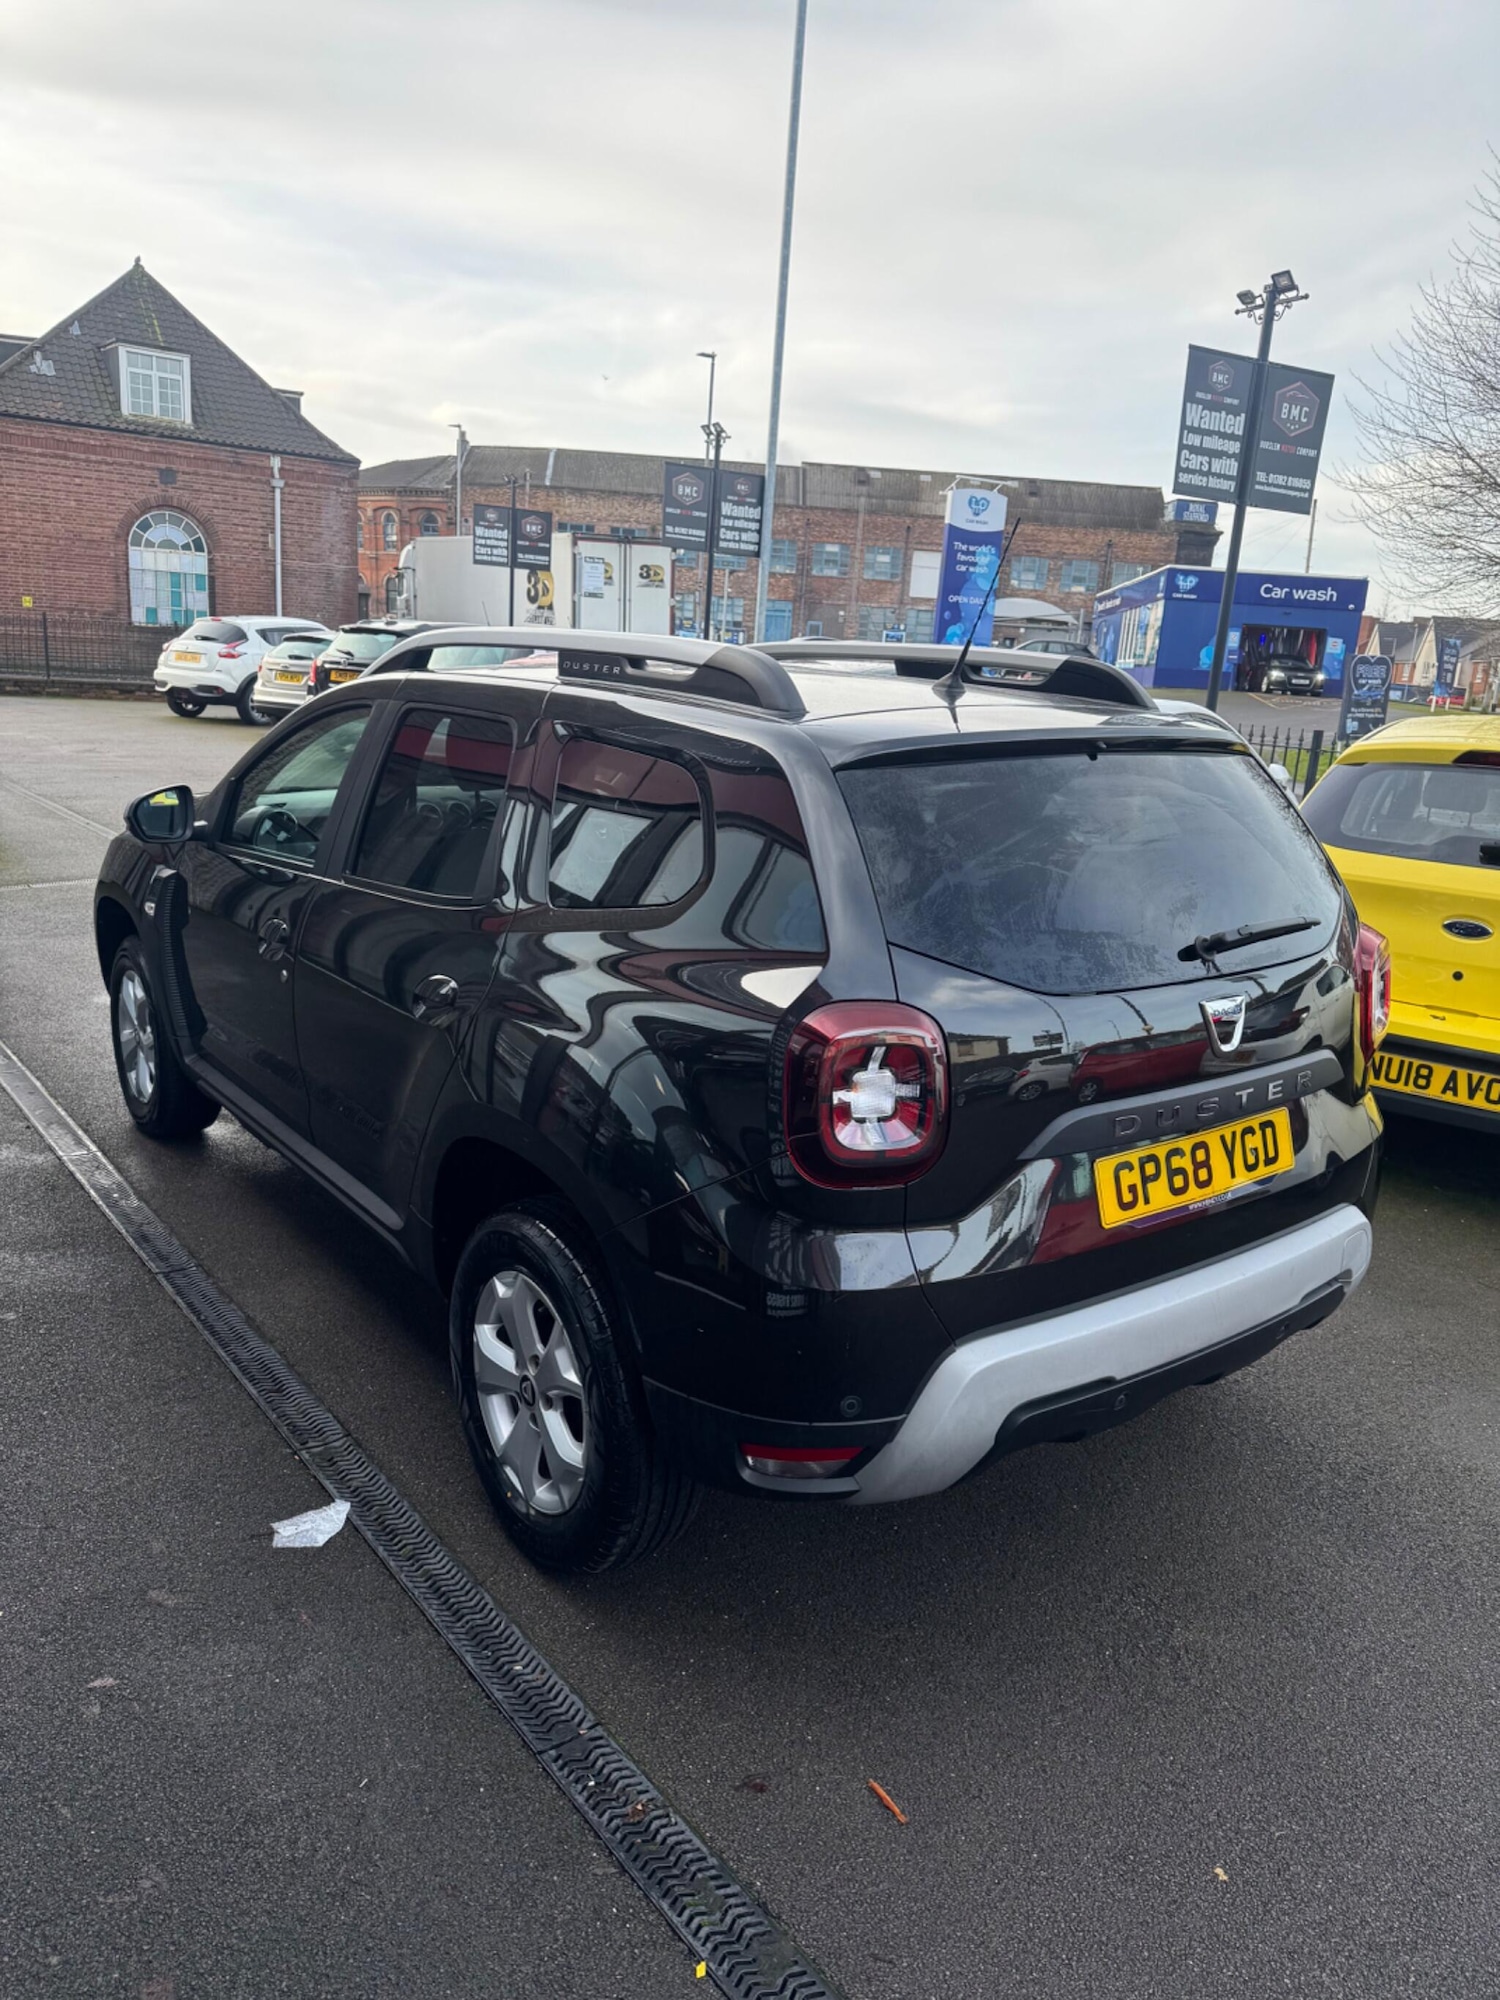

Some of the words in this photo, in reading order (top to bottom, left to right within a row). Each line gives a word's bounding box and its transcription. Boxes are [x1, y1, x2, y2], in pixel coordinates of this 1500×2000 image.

[1212, 371, 1229, 385] BMC
[1185, 402, 1246, 436] Wanted
[1280, 402, 1310, 423] BMC
[1182, 429, 1203, 446] Low
[1202, 432, 1241, 454] mileage
[1180, 449, 1210, 472] Cars
[1210, 455, 1239, 477] with
[677, 484, 699, 497] BMC
[1178, 472, 1208, 488] service
[1207, 475, 1236, 493] history
[720, 501, 762, 520] Wanted
[719, 527, 740, 540] Cars
[953, 541, 968, 552] The
[968, 544, 996, 555] world's
[955, 565, 969, 573] car
[948, 594, 969, 604] OPEN
[1260, 583, 1290, 599] Car
[1292, 586, 1338, 602] wash
[561, 660, 621, 675] DUSTER
[1114, 1070, 1312, 1138] DUSTER
[1113, 1140, 1213, 1213] GP68
[1219, 1119, 1280, 1180] YGD
